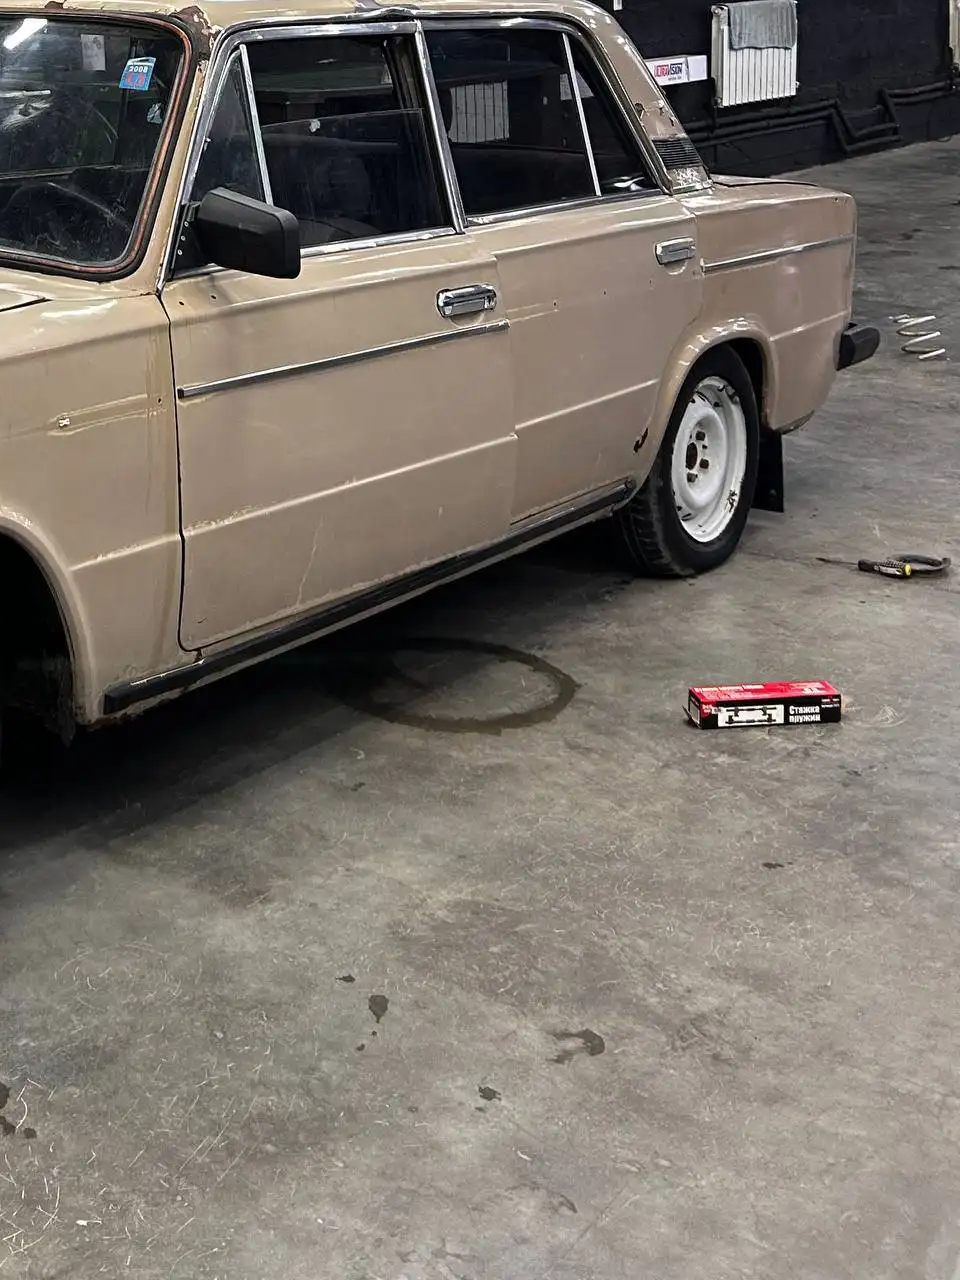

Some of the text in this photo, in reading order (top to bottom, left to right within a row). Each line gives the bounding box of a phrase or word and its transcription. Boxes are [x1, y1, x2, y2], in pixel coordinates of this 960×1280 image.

[128, 65, 149, 73] 2008
[789, 705, 820, 714] Стяжка
[789, 714, 821, 723] пружин
